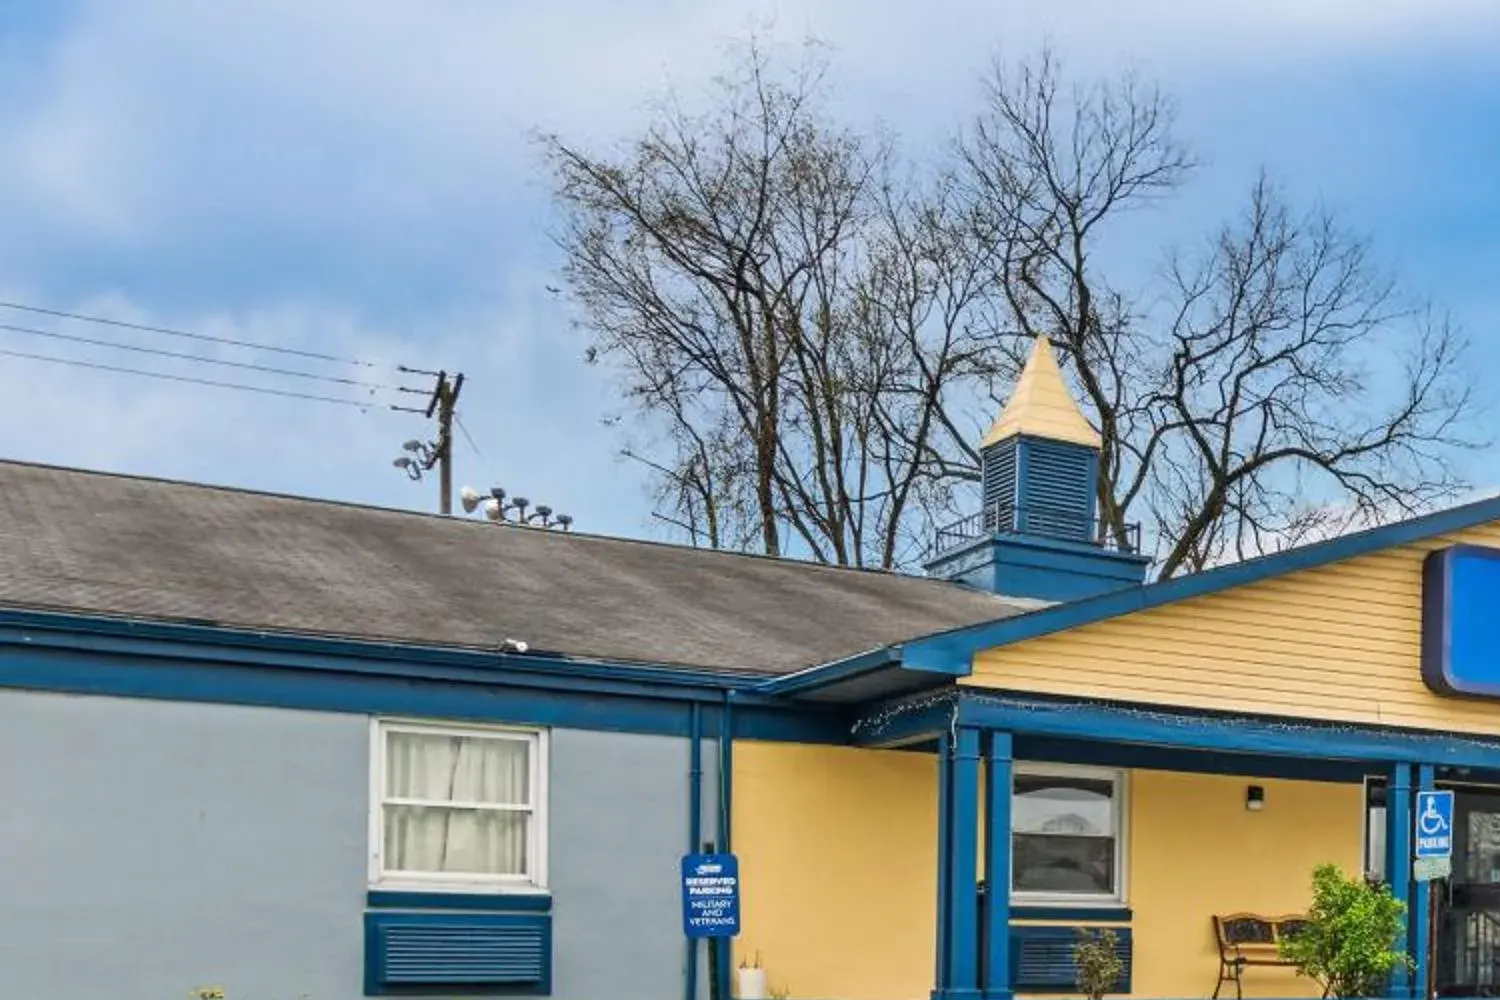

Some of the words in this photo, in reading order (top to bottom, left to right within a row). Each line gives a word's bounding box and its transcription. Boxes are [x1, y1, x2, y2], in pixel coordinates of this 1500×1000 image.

[689, 887, 733, 895] PARKING
[691, 900, 731, 909] MILITARY
[701, 909, 723, 917] AND
[689, 917, 735, 925] VETERANS
